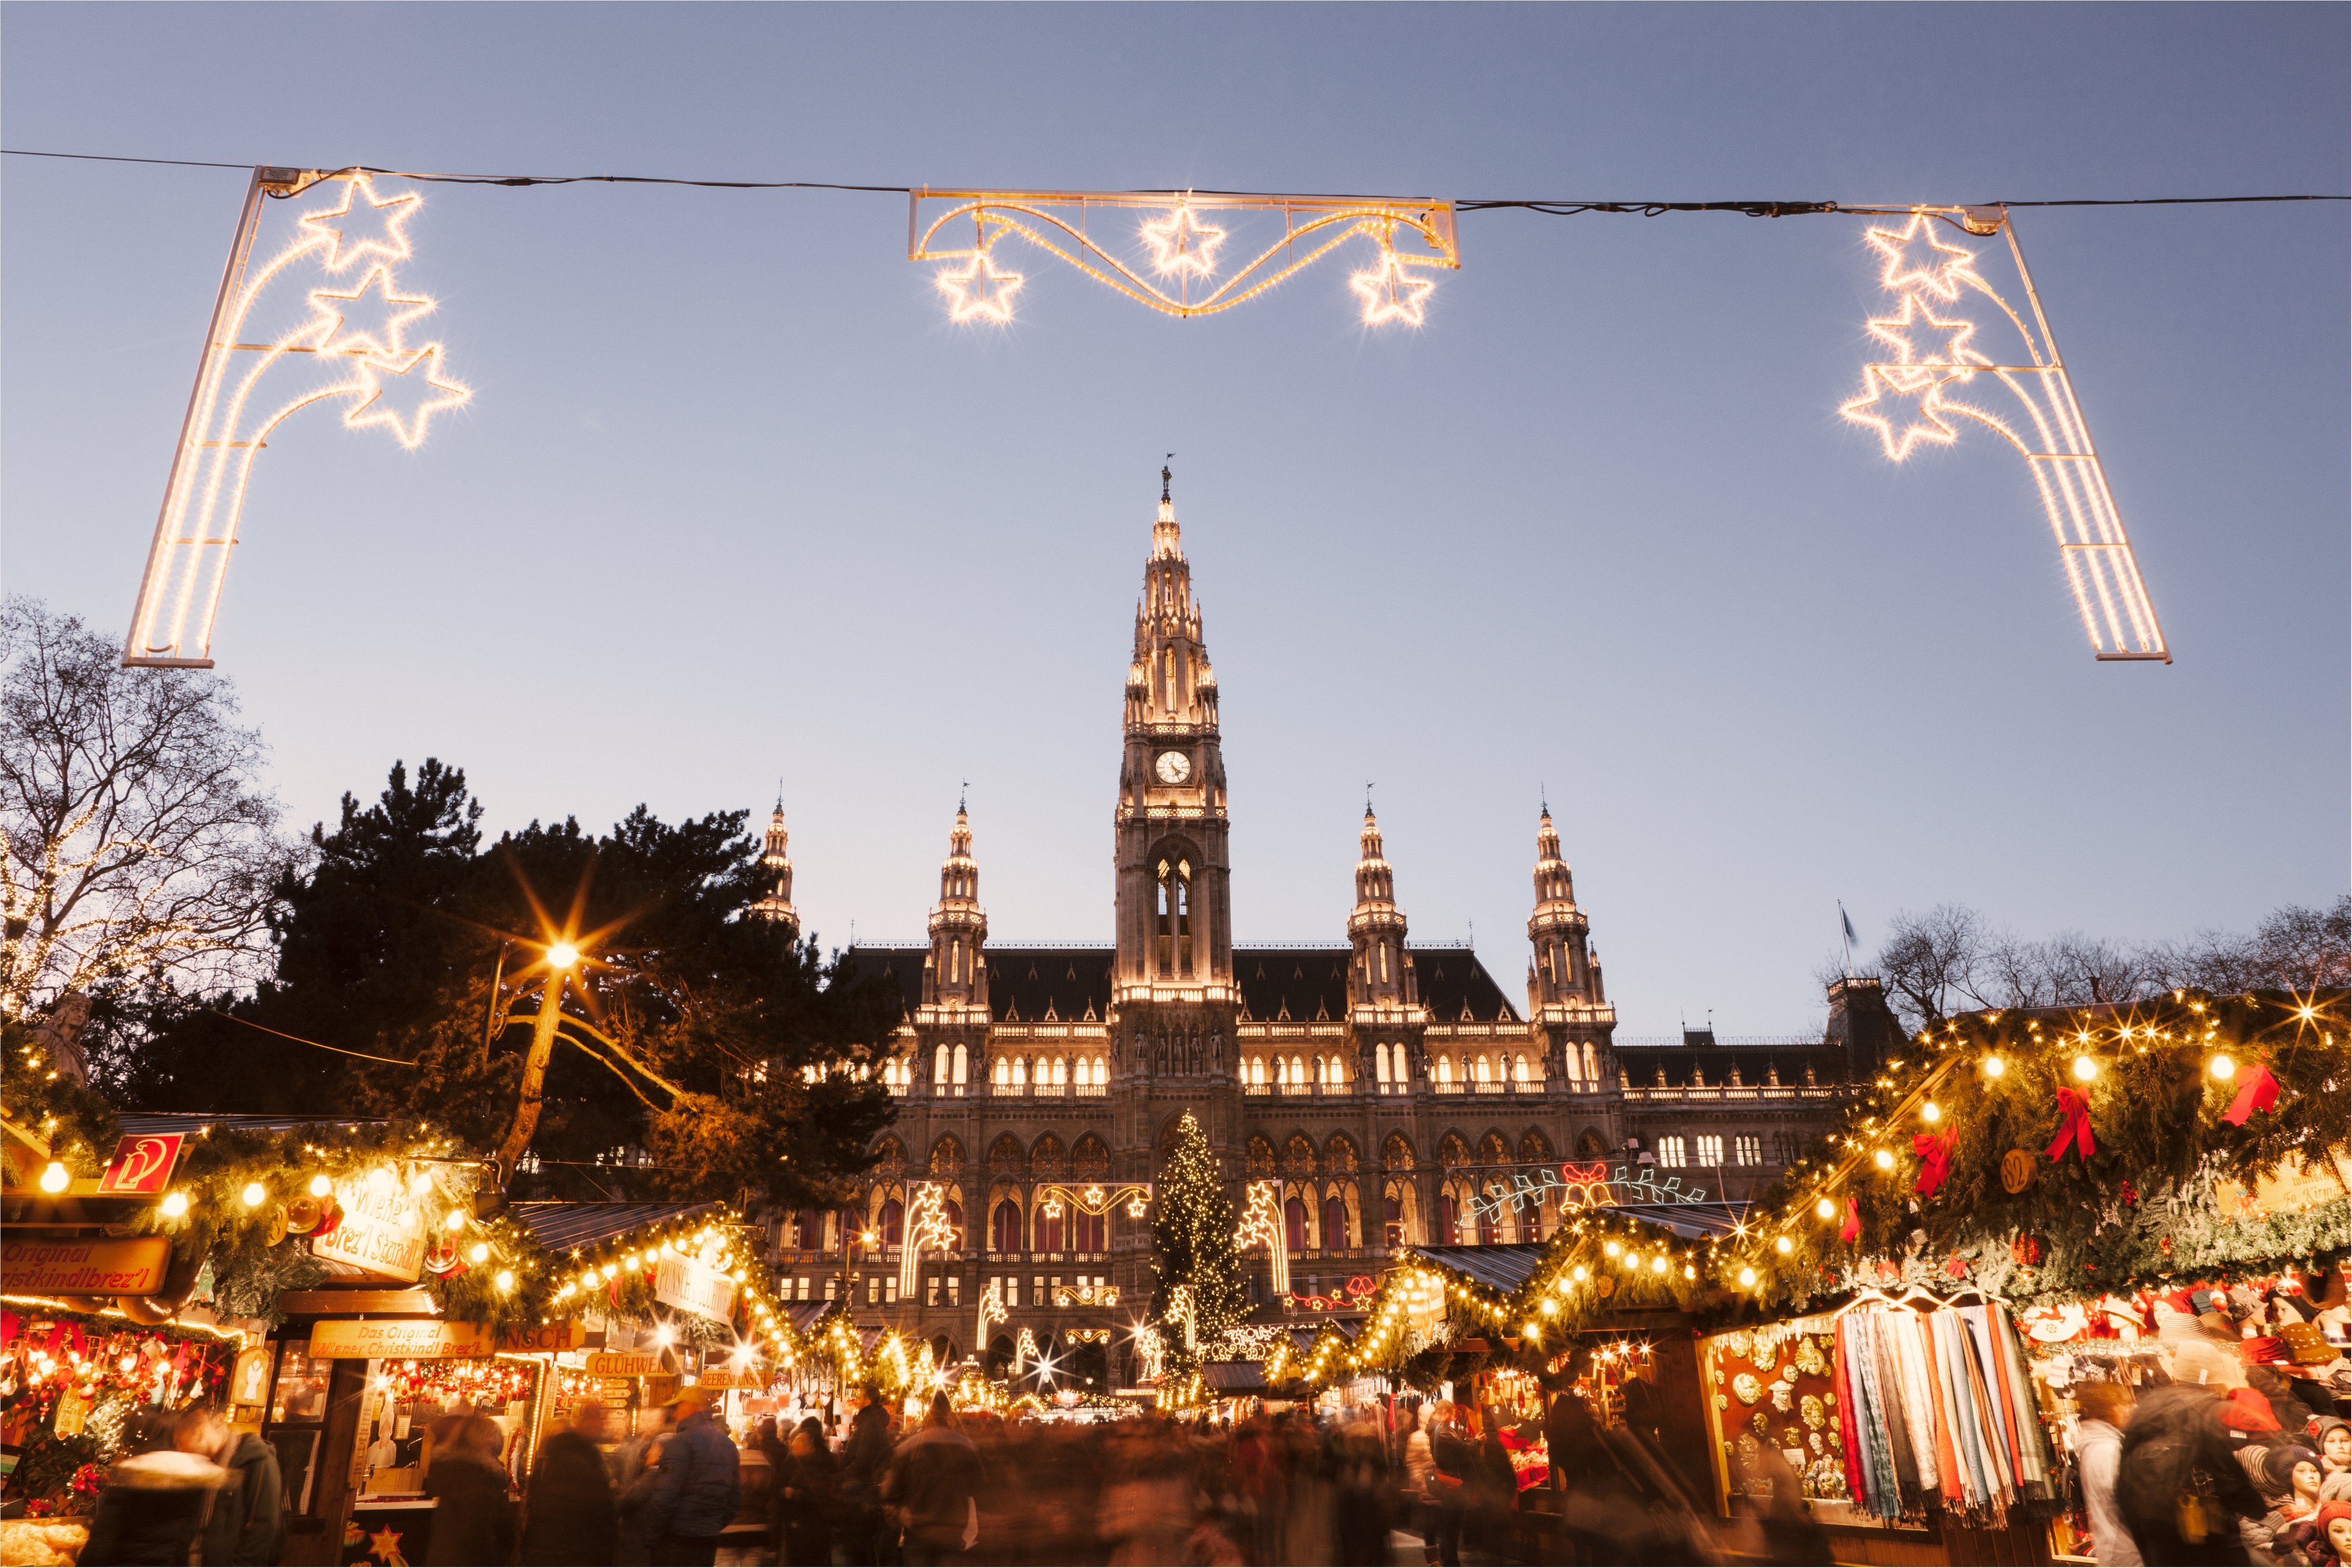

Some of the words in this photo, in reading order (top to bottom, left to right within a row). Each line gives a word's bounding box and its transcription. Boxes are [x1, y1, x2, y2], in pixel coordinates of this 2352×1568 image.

[3, 1243, 95, 1267] Original
[370, 1230, 419, 1271] Standl
[659, 1258, 692, 1301] PUNSCH
[358, 1327, 384, 1339] Das
[503, 1327, 573, 1349] NSCH
[316, 1342, 365, 1356] Wiener
[367, 1341, 440, 1355] Christkindl
[595, 1354, 666, 1373] GLÜHWEI
